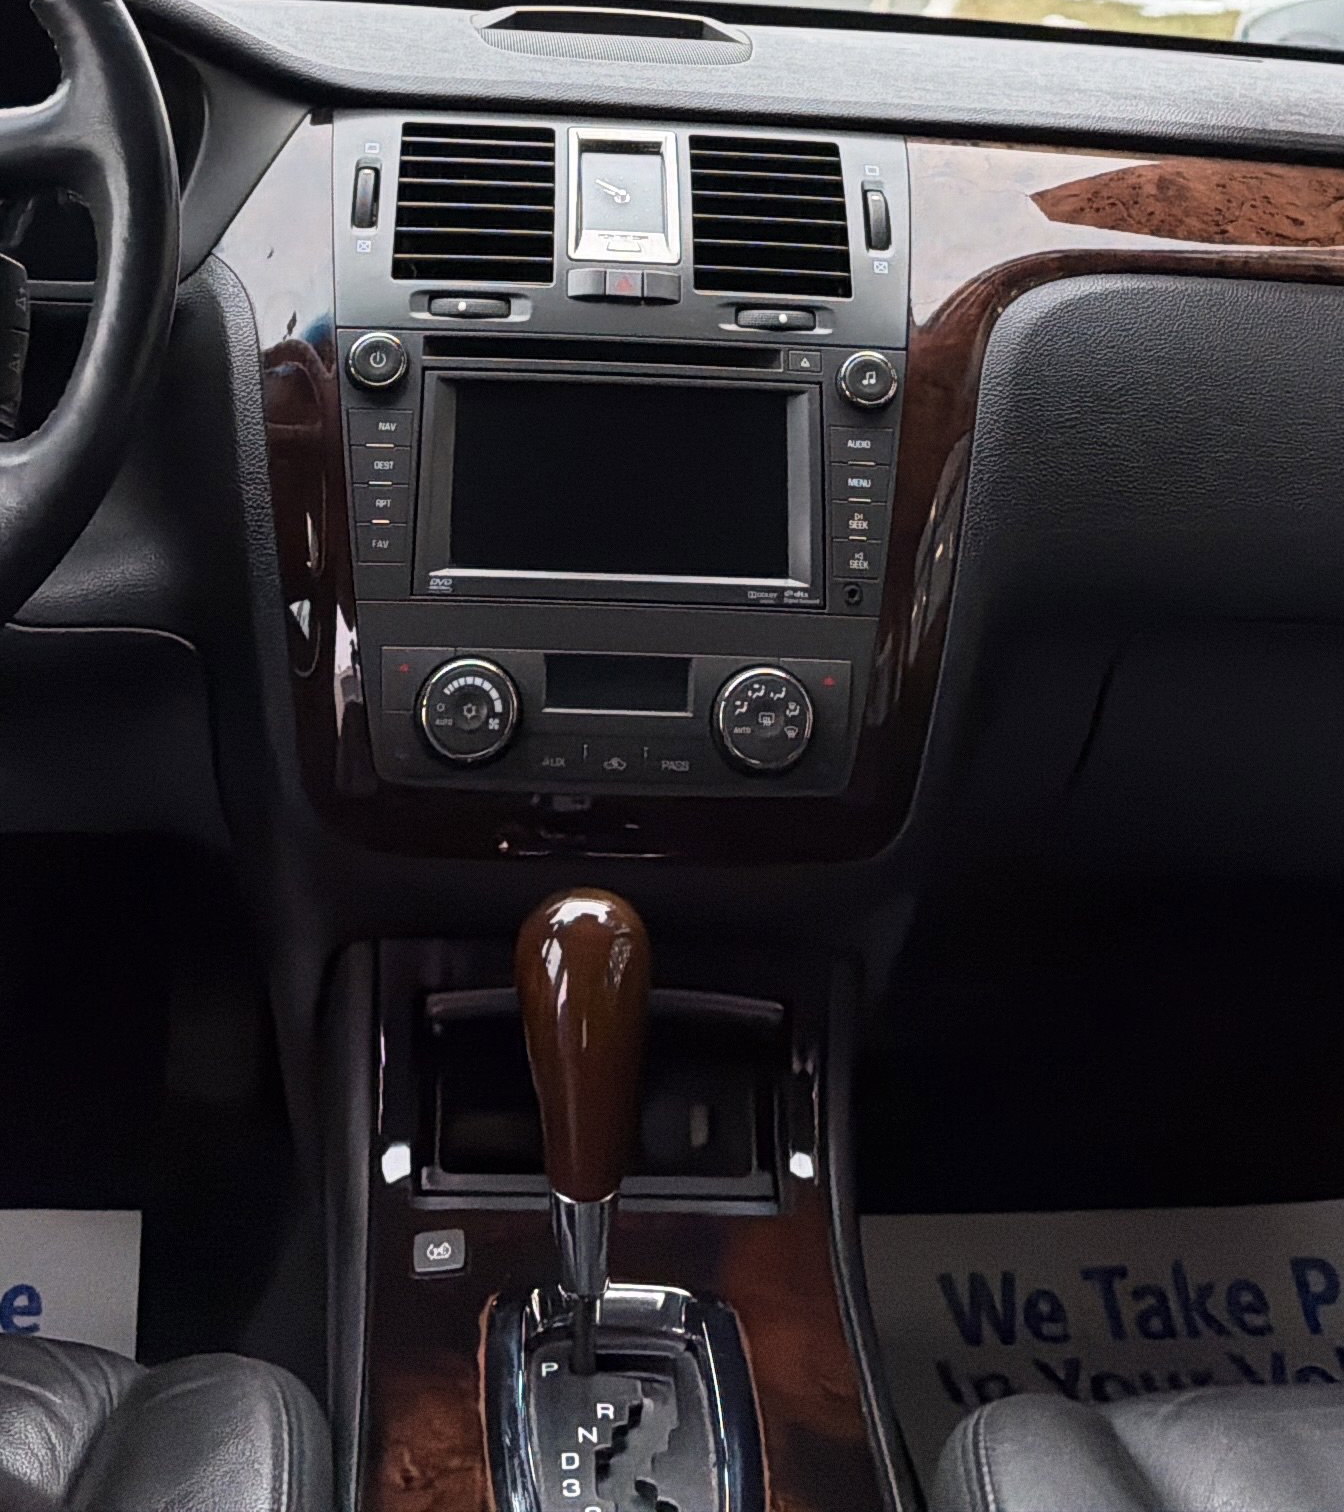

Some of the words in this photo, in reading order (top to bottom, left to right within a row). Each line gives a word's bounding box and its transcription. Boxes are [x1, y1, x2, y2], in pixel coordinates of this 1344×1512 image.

[377, 422, 397, 432] NAV
[847, 439, 872, 449] AUDIO
[374, 460, 395, 470] DEST
[847, 478, 872, 488] MENU
[848, 520, 869, 529] SEEK
[372, 540, 390, 549] FAV
[849, 560, 869, 569] SEEK
[430, 578, 453, 586] DVD
[936, 1270, 1072, 1348] We
[1081, 1258, 1274, 1342] Take
[541, 1362, 559, 1378] P
[596, 1402, 615, 1420] R
[577, 1426, 598, 1444] N
[560, 1452, 580, 1470] D
[562, 1478, 581, 1498] 3
